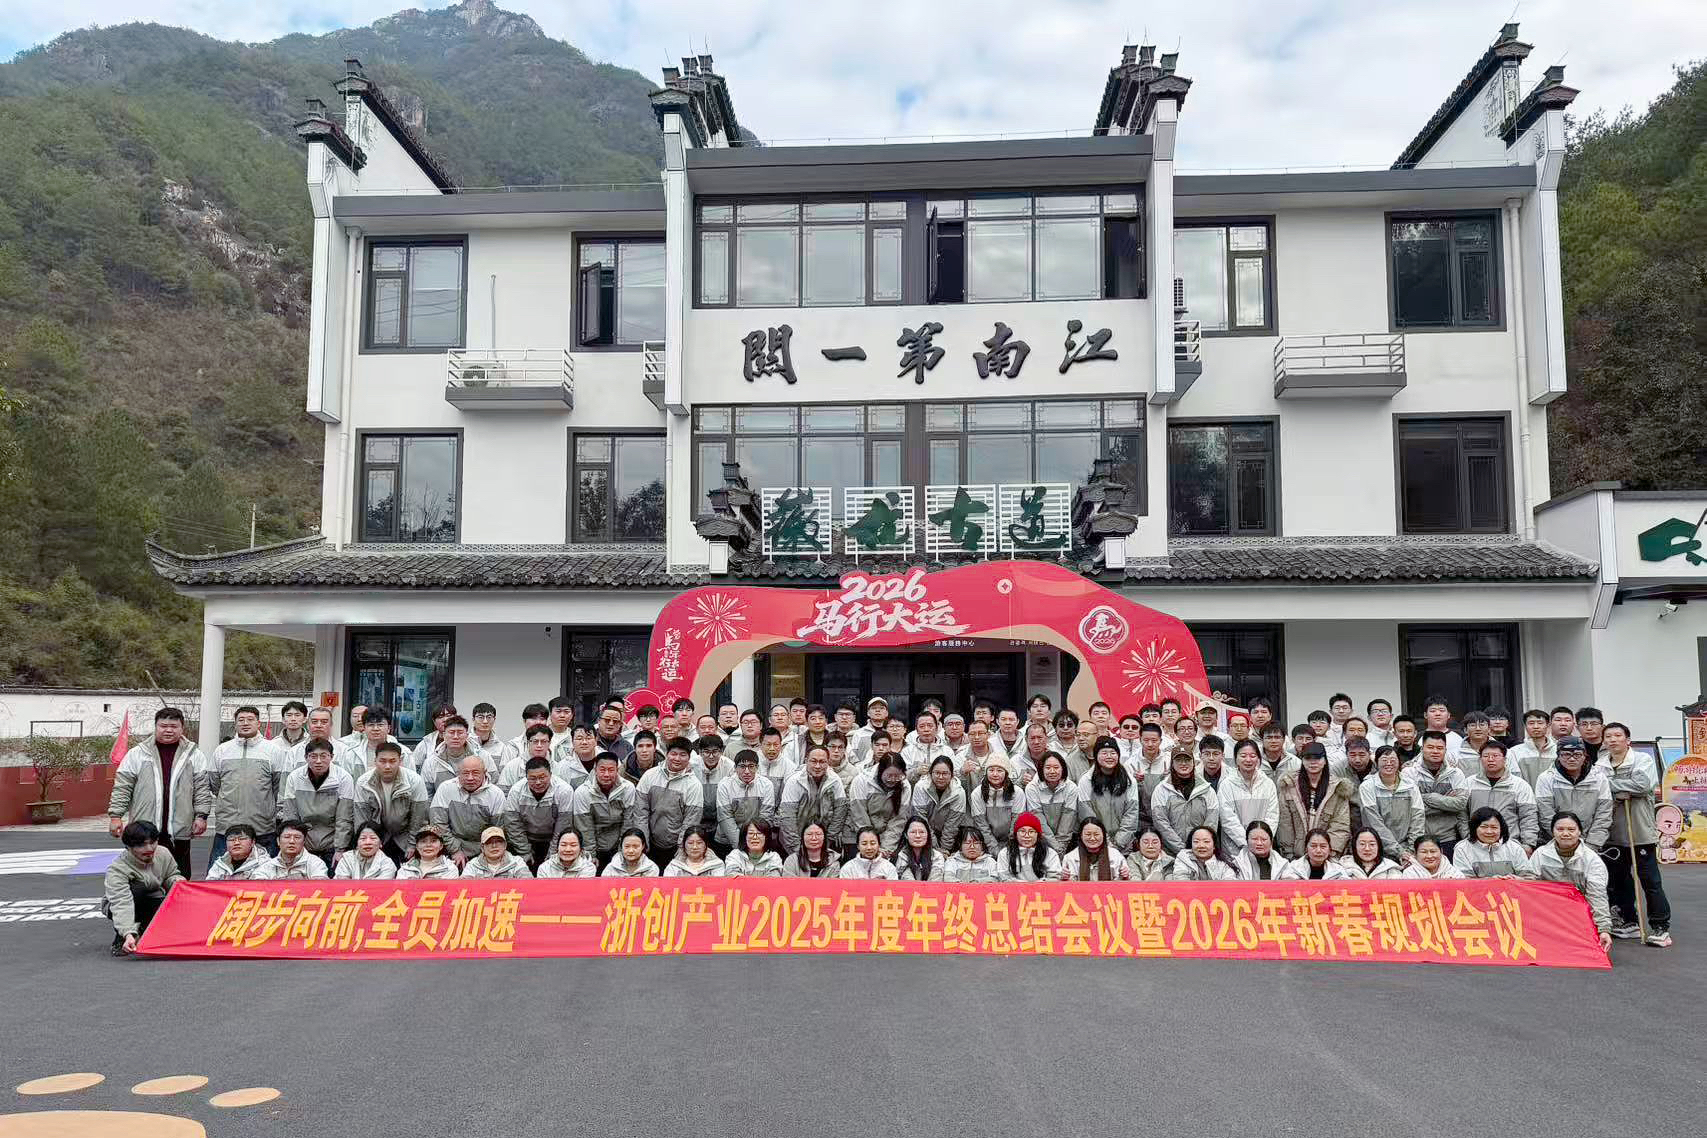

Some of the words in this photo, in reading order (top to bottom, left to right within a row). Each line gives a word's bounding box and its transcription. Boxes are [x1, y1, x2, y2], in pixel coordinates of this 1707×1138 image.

[840, 569, 927, 604] 2026
[796, 600, 971, 640] 马行大运
